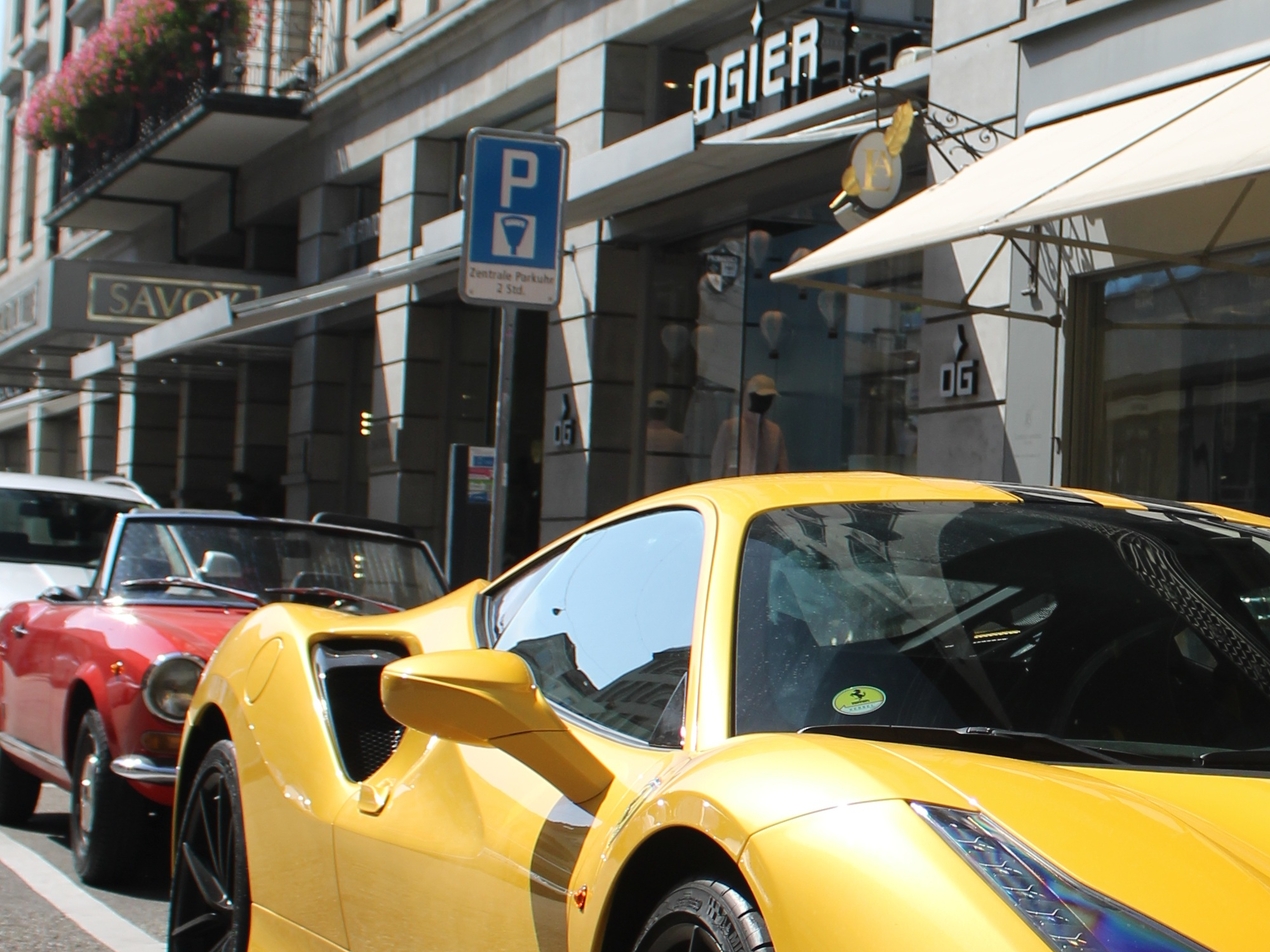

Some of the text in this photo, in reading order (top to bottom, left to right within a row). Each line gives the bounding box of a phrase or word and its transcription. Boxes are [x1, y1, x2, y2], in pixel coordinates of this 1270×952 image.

[693, 18, 819, 126] OGIER
[501, 148, 539, 209] P
[470, 267, 554, 284] Zentrale Parkuhr
[496, 282, 525, 295] 2 Std.
[940, 360, 974, 397] OG
